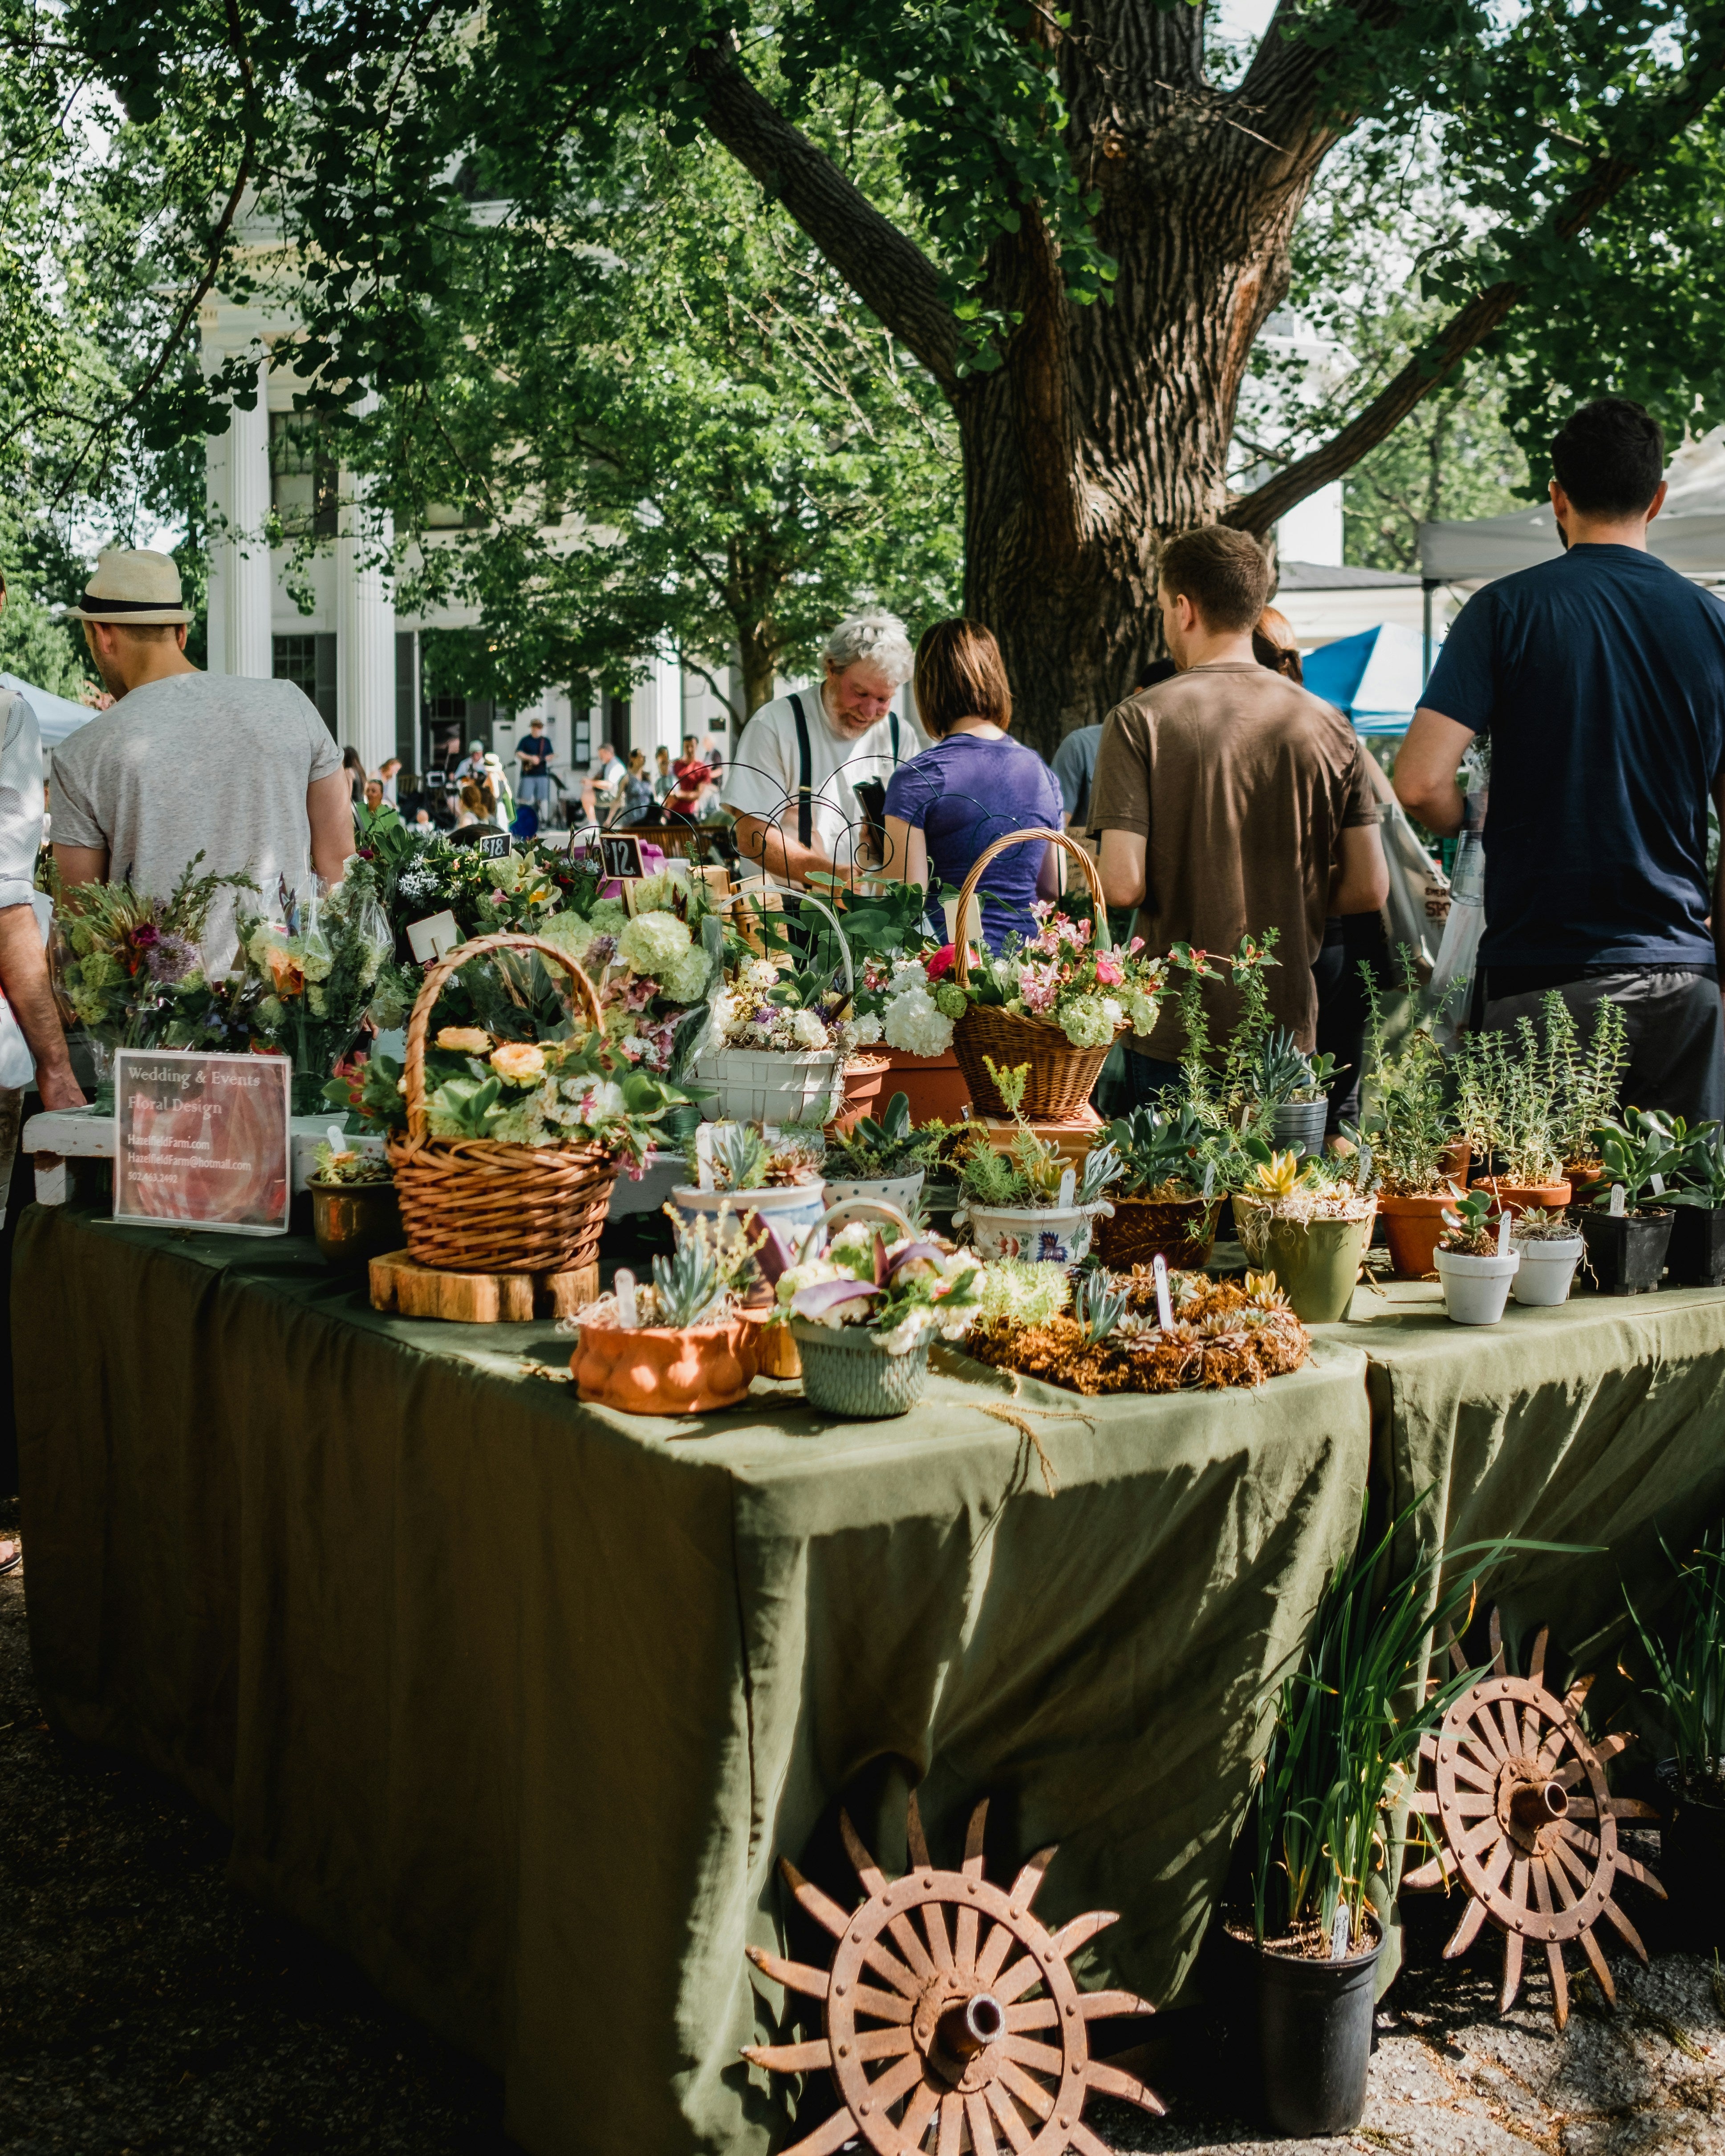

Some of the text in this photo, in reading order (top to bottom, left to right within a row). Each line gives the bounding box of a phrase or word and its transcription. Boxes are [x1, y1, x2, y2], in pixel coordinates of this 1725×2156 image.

[128, 1067, 261, 1089] Wedding & Events
[127, 1096, 222, 1119] Floral Design
[128, 1135, 210, 1150] HazelfieldFarm.com
[128, 1152, 251, 1170] HazelfieldFarm@hotmail.com
